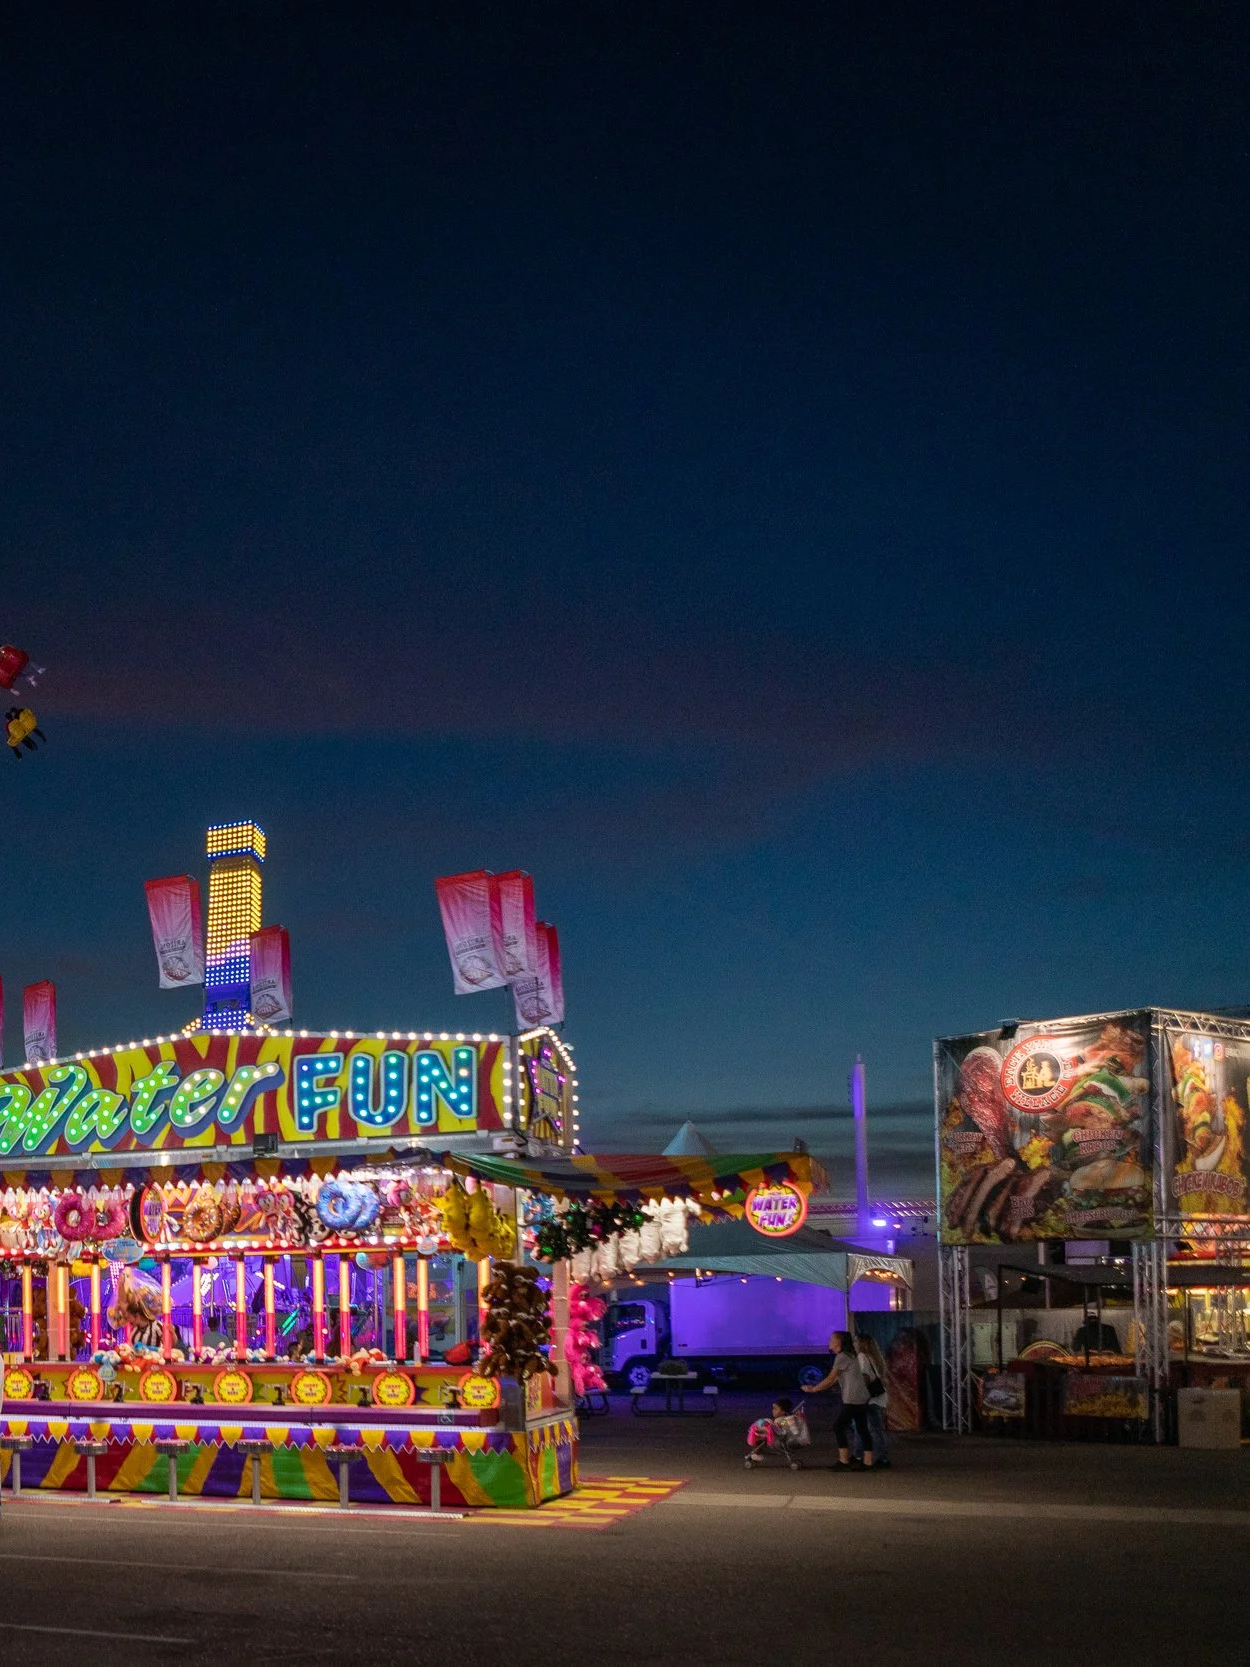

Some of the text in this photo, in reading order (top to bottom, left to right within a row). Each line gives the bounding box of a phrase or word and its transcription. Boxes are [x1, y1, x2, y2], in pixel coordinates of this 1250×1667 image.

[294, 1046, 477, 1132] FUN
[1010, 1083, 1068, 1110] VILLAGE
[752, 1195, 798, 1211] WATER
[758, 1211, 794, 1227] FUN!
